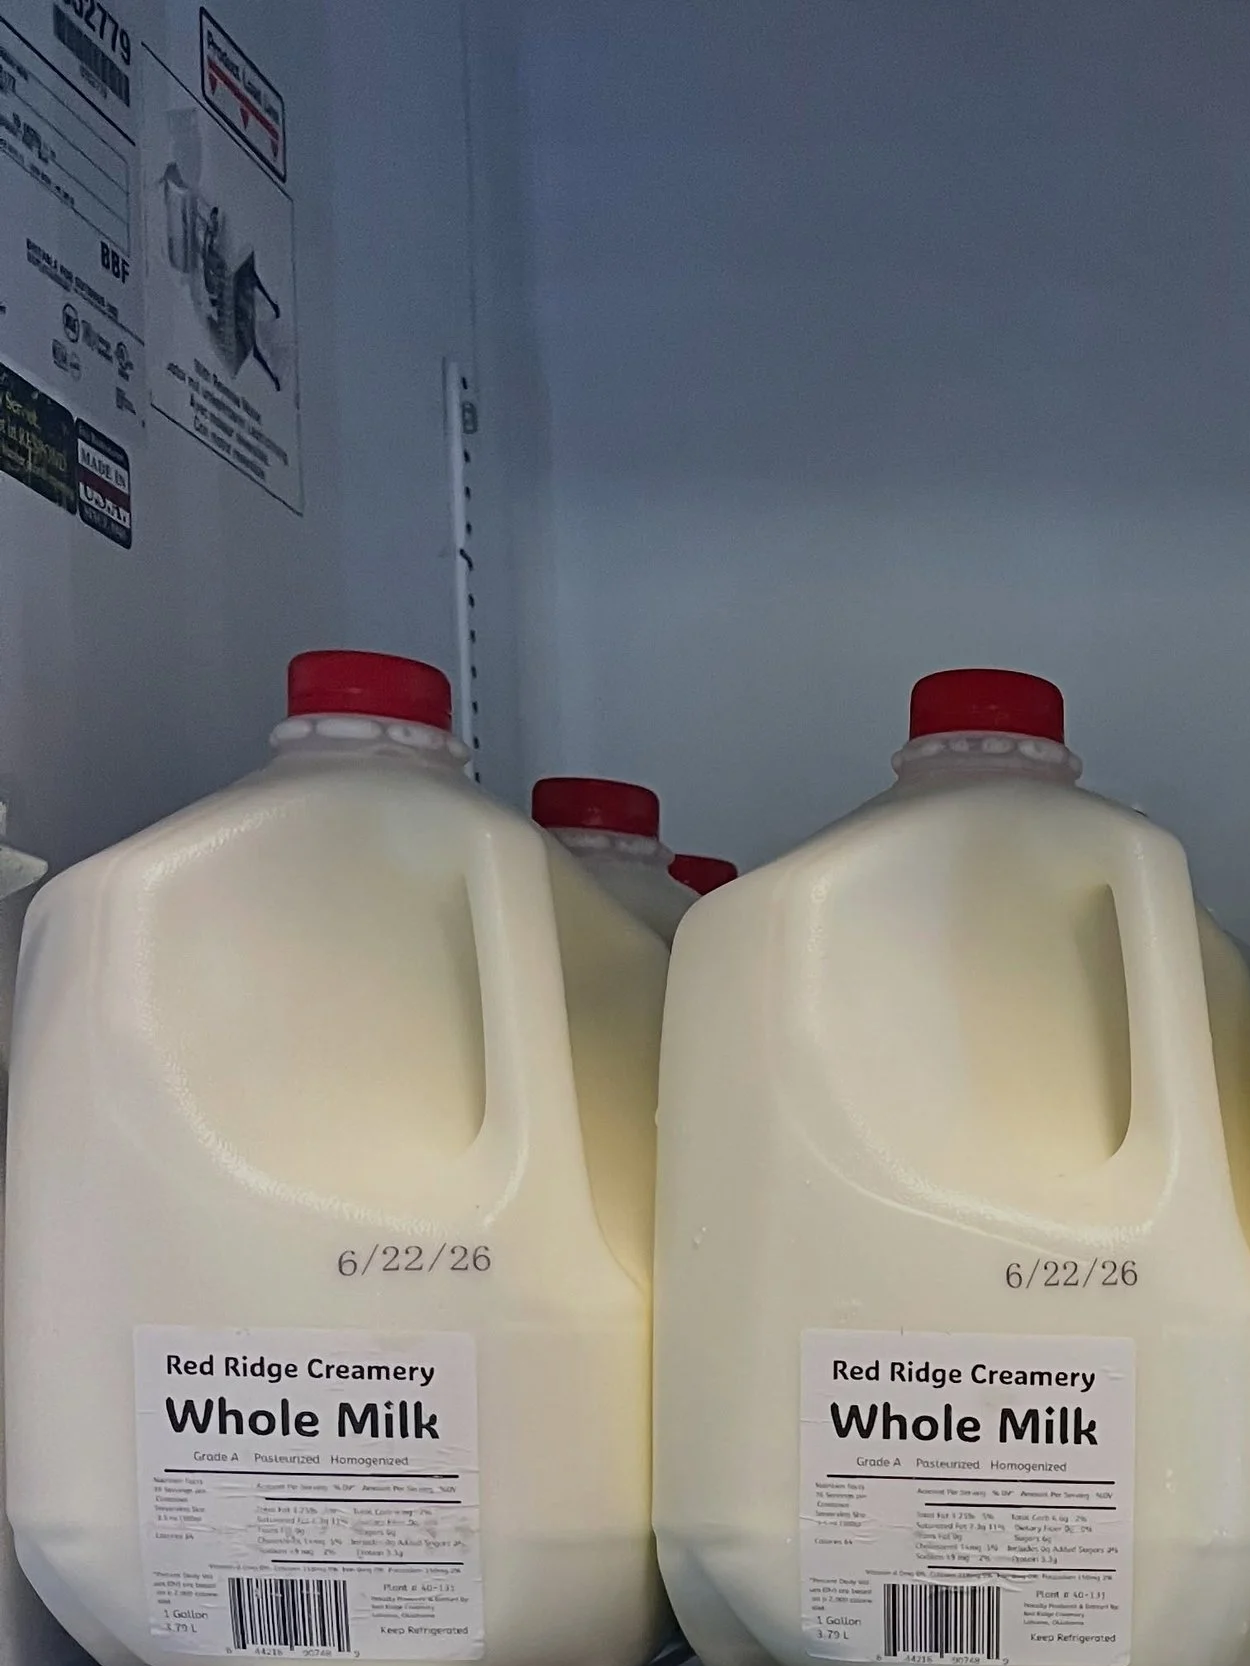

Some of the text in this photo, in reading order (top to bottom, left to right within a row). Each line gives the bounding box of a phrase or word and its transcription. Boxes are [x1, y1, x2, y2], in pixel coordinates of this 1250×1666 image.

[338, 1243, 491, 1276] 6/22/26
[1005, 1258, 1138, 1289] 6/22/26
[167, 1355, 435, 1386] Red Ridge Creamery
[833, 1360, 1096, 1392] Red Ridge Creamery
[165, 1397, 439, 1439] Whole Milk
[831, 1402, 1098, 1445] Whole Milk
[194, 1451, 408, 1467] Grade A Pasteurized Homogenized
[857, 1457, 1067, 1473] Grade A Pasteurized Homogenized
[172, 1610, 208, 1620] Gallon
[826, 1615, 861, 1626] Gallon
[381, 1625, 468, 1637] Keep Refrigerated
[1031, 1632, 1116, 1644] Keep Refrigerated
